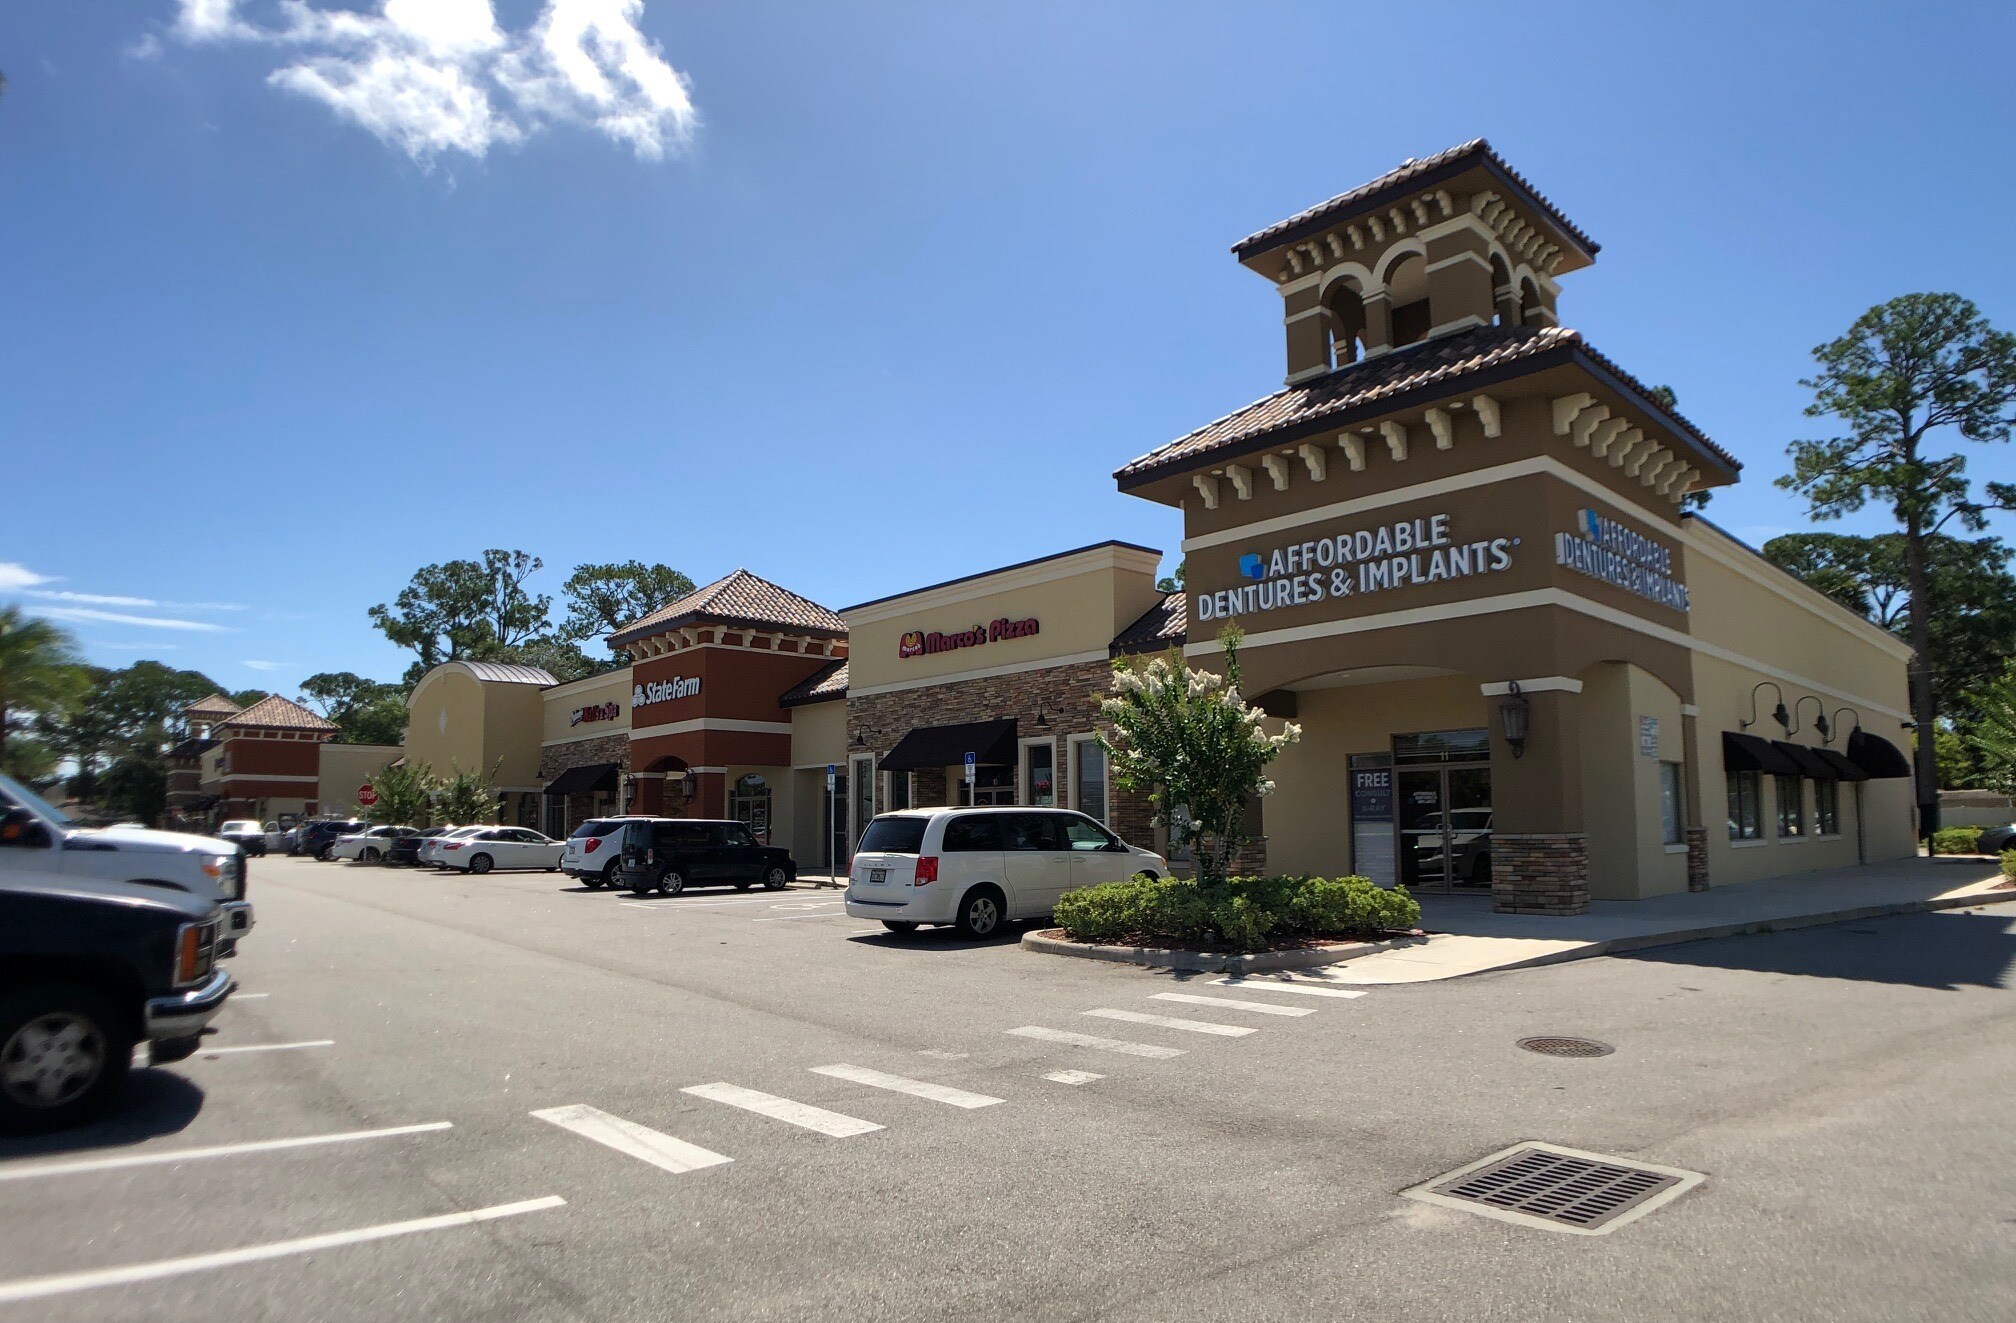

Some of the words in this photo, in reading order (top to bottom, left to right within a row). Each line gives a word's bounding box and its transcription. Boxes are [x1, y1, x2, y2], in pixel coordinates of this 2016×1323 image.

[1269, 513, 1449, 577] AFFORDABLE
[1555, 532, 1630, 588] DENTURES
[1597, 517, 1670, 575] AFFORDABLE
[1198, 572, 1325, 621] DENTURES
[1329, 568, 1353, 598] &
[1358, 536, 1510, 594] IMPLANTS
[926, 625, 986, 654] Marco's
[989, 618, 1039, 642] Pizza
[359, 790, 377, 800] STOP
[1357, 773, 1389, 787] FREE
